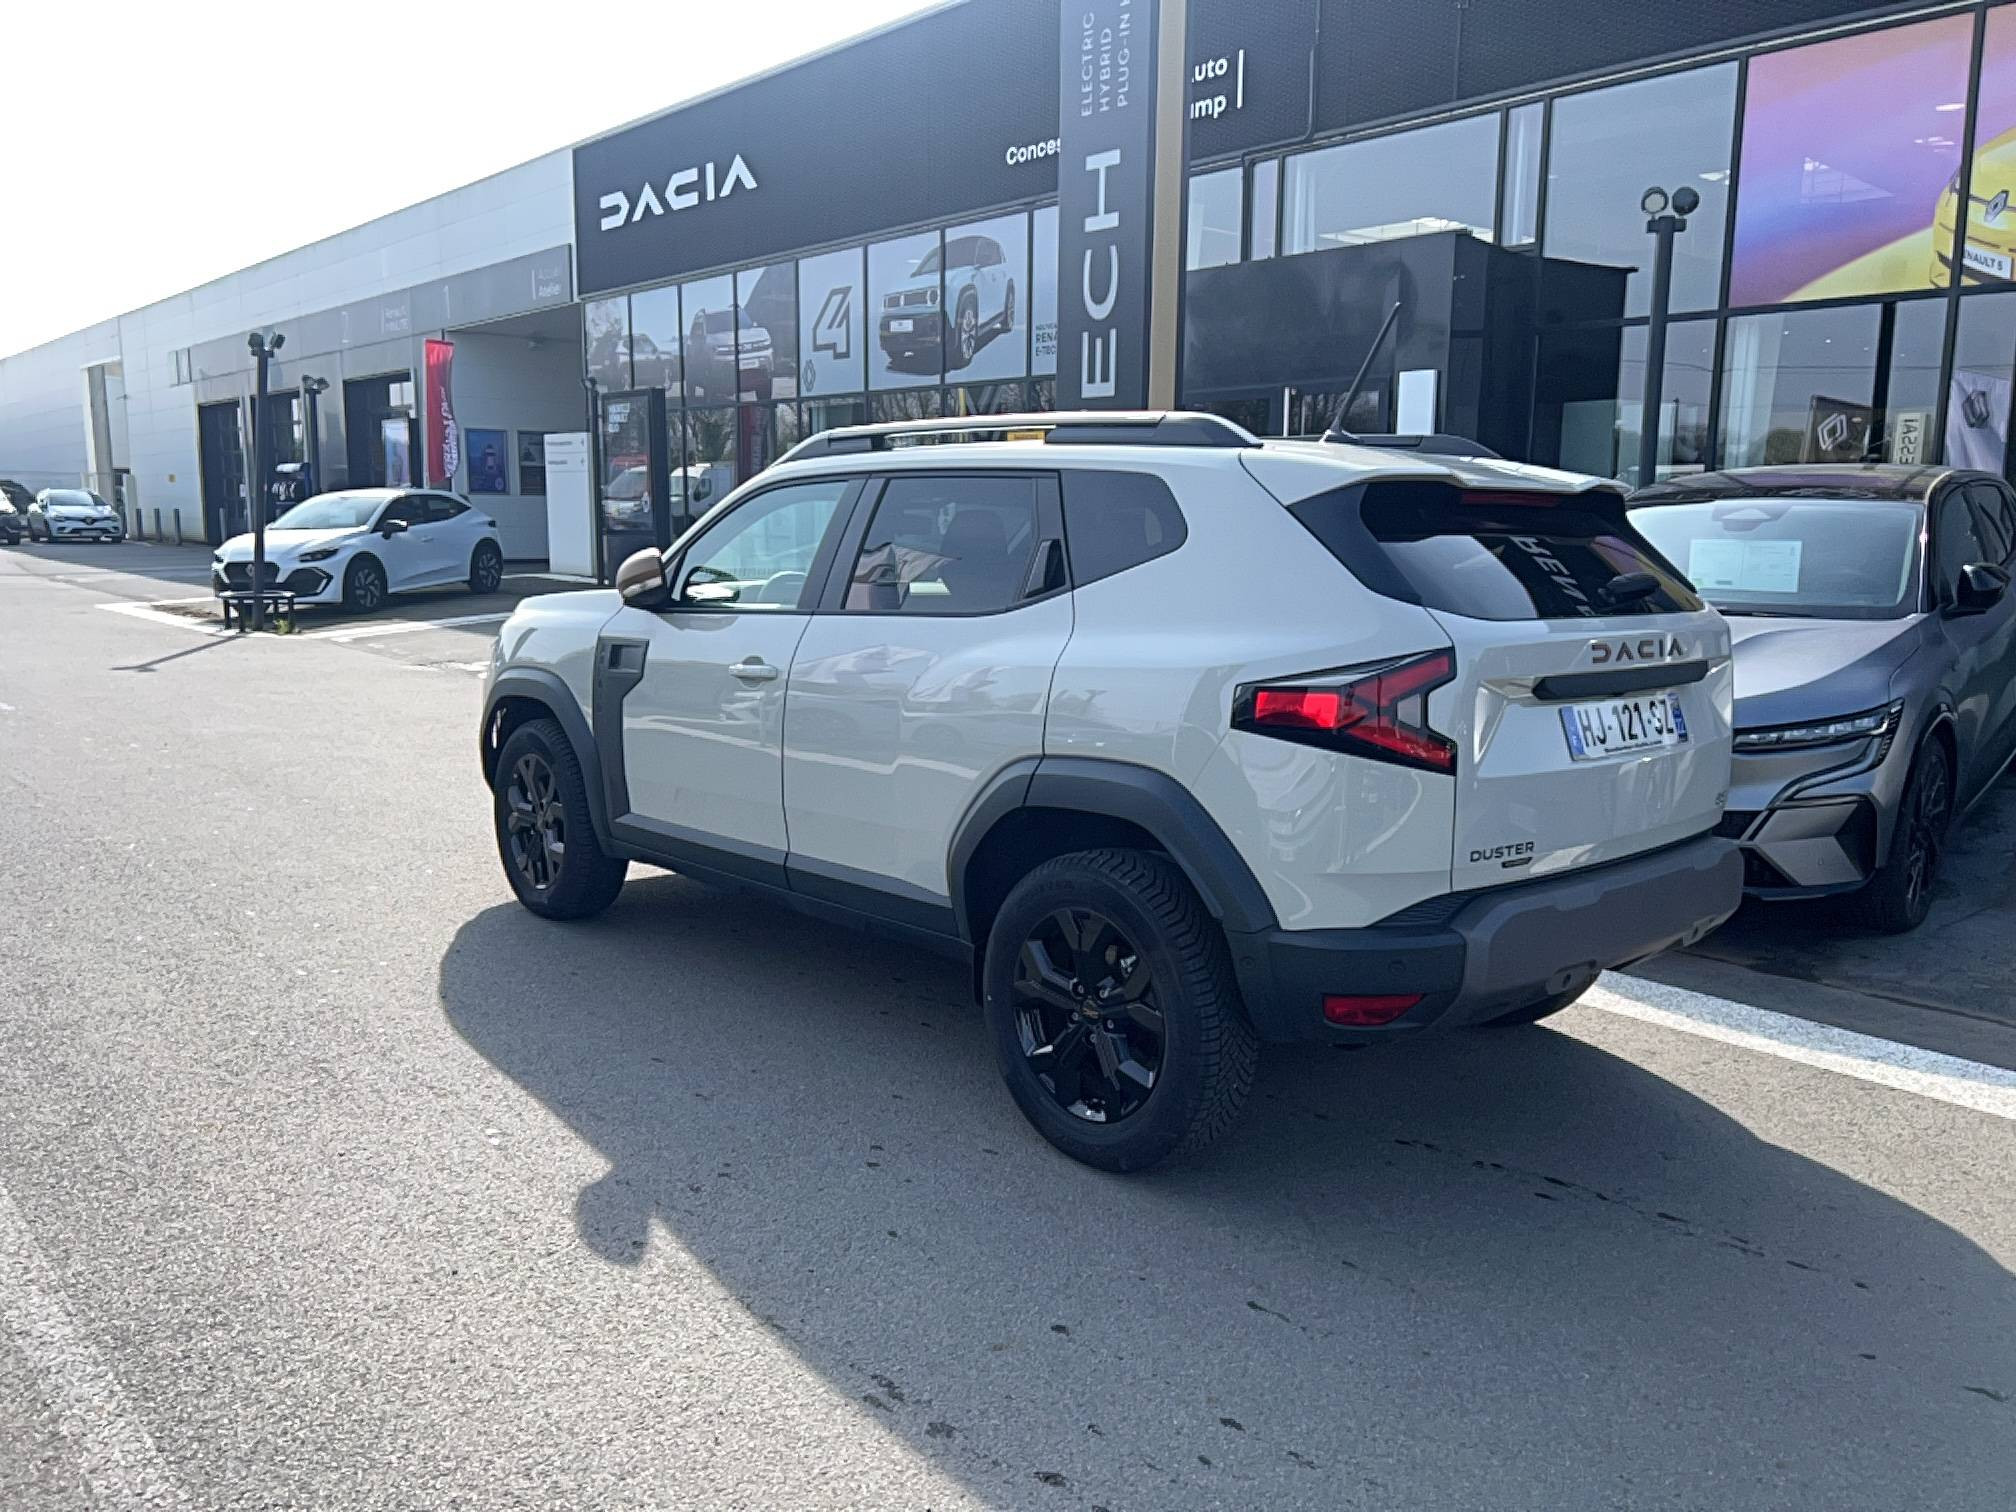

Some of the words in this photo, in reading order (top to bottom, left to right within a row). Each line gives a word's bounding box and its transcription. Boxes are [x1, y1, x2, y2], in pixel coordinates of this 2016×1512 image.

[1081, 12, 1094, 116] ELECTRIC
[1099, 28, 1111, 111] HYBRID
[1118, 13, 1131, 107] PLUG-IN
[1192, 58, 1228, 83] uto
[600, 153, 758, 231] DACIA
[812, 285, 853, 360] 4
[1591, 638, 1684, 664] DACIA
[1577, 700, 1674, 748] HJ-121-SZ
[1470, 841, 1534, 862] DUSTER
